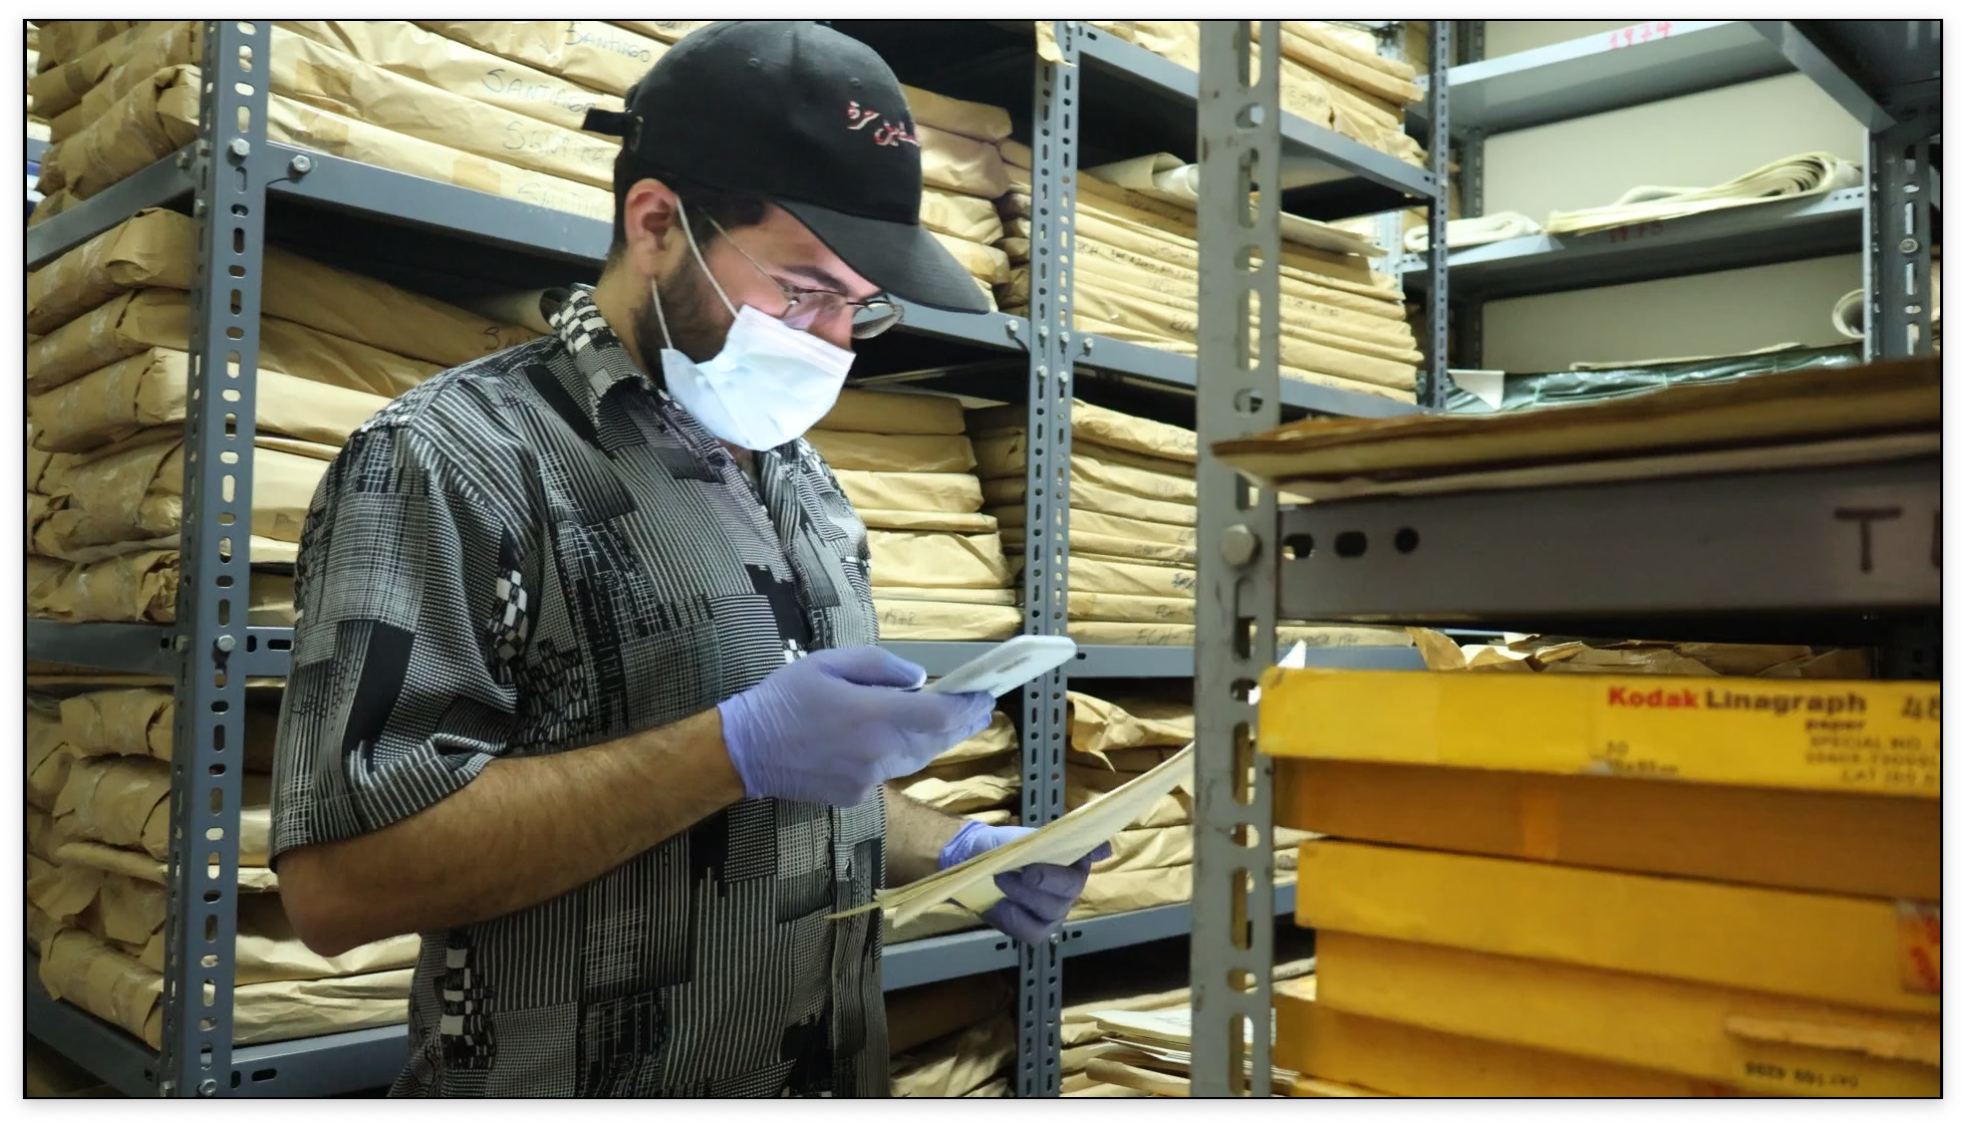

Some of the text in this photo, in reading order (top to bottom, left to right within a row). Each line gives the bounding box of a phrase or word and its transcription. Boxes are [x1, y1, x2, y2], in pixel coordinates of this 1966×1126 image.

[1607, 687, 1698, 709] Kodak
[1705, 690, 1867, 716] Linagraph
[1805, 719, 1866, 731] paper
